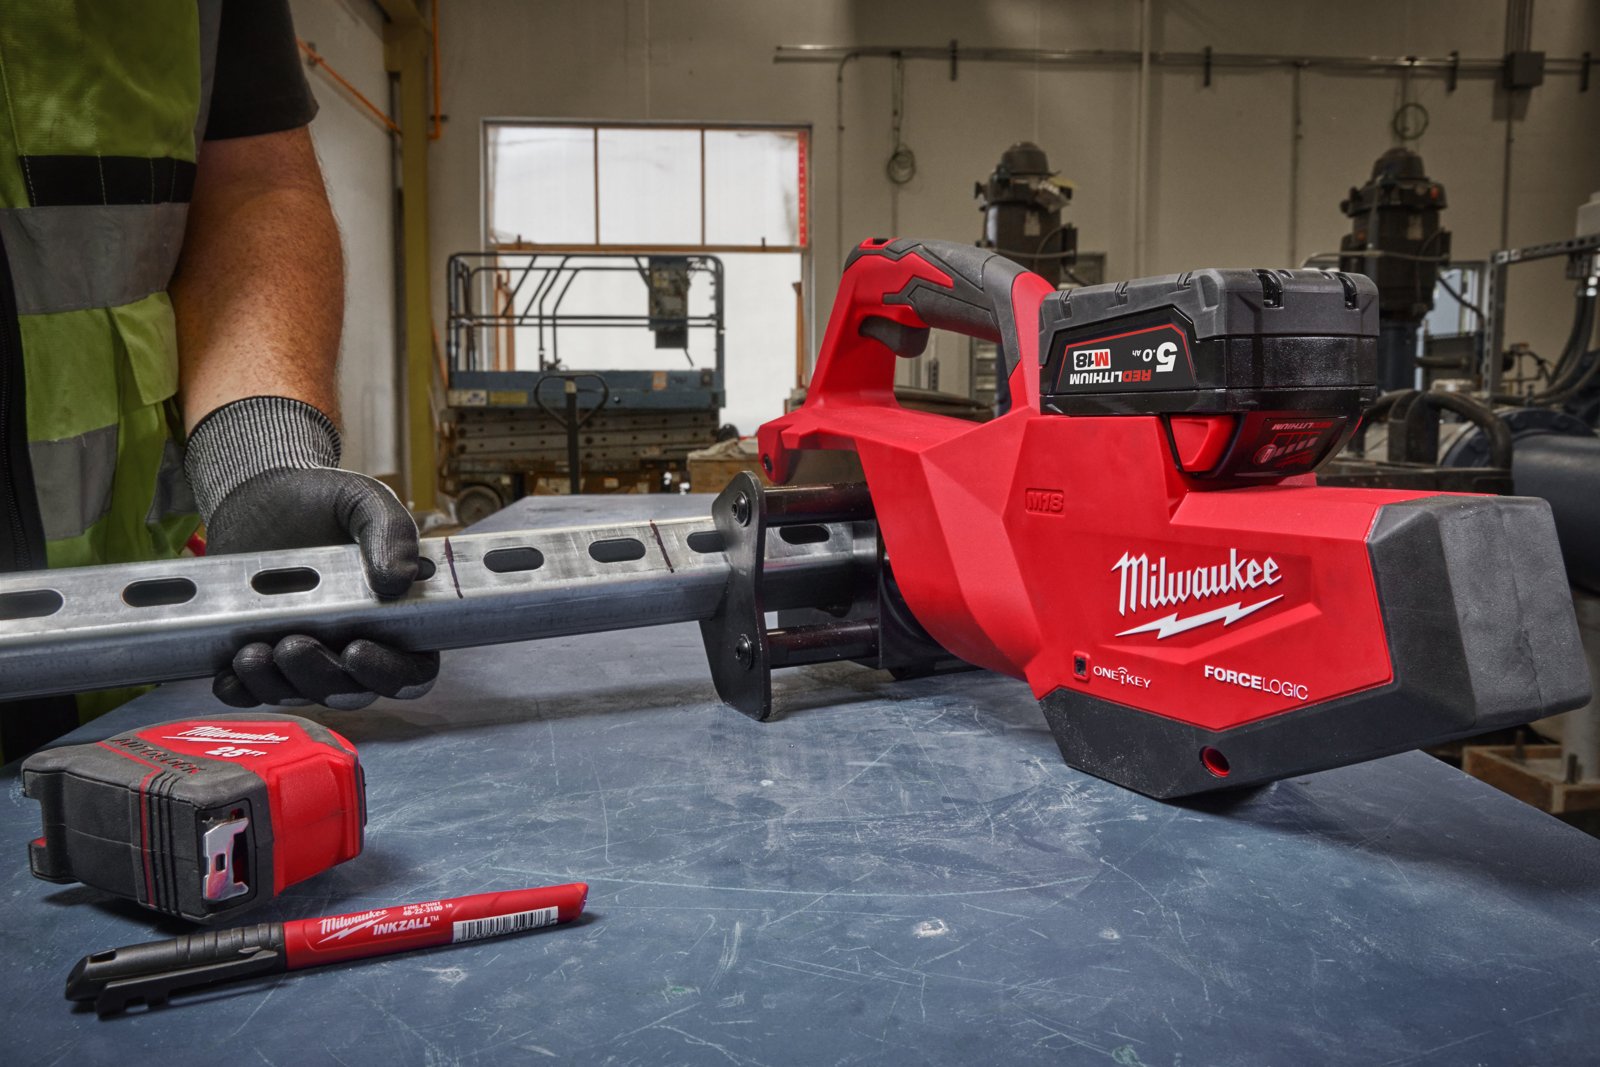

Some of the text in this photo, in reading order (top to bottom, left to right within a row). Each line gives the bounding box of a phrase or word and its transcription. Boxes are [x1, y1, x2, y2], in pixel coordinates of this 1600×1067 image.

[1075, 351, 1110, 369] M18
[1142, 341, 1178, 372] 5.0
[1069, 369, 1152, 385] REDLITHIUM
[1026, 490, 1064, 513] M18
[1111, 548, 1282, 616] Milwaukee
[1204, 665, 1309, 701] FORCELOGIC
[177, 726, 289, 742] Milwaukee
[318, 909, 389, 936] Milwaukee
